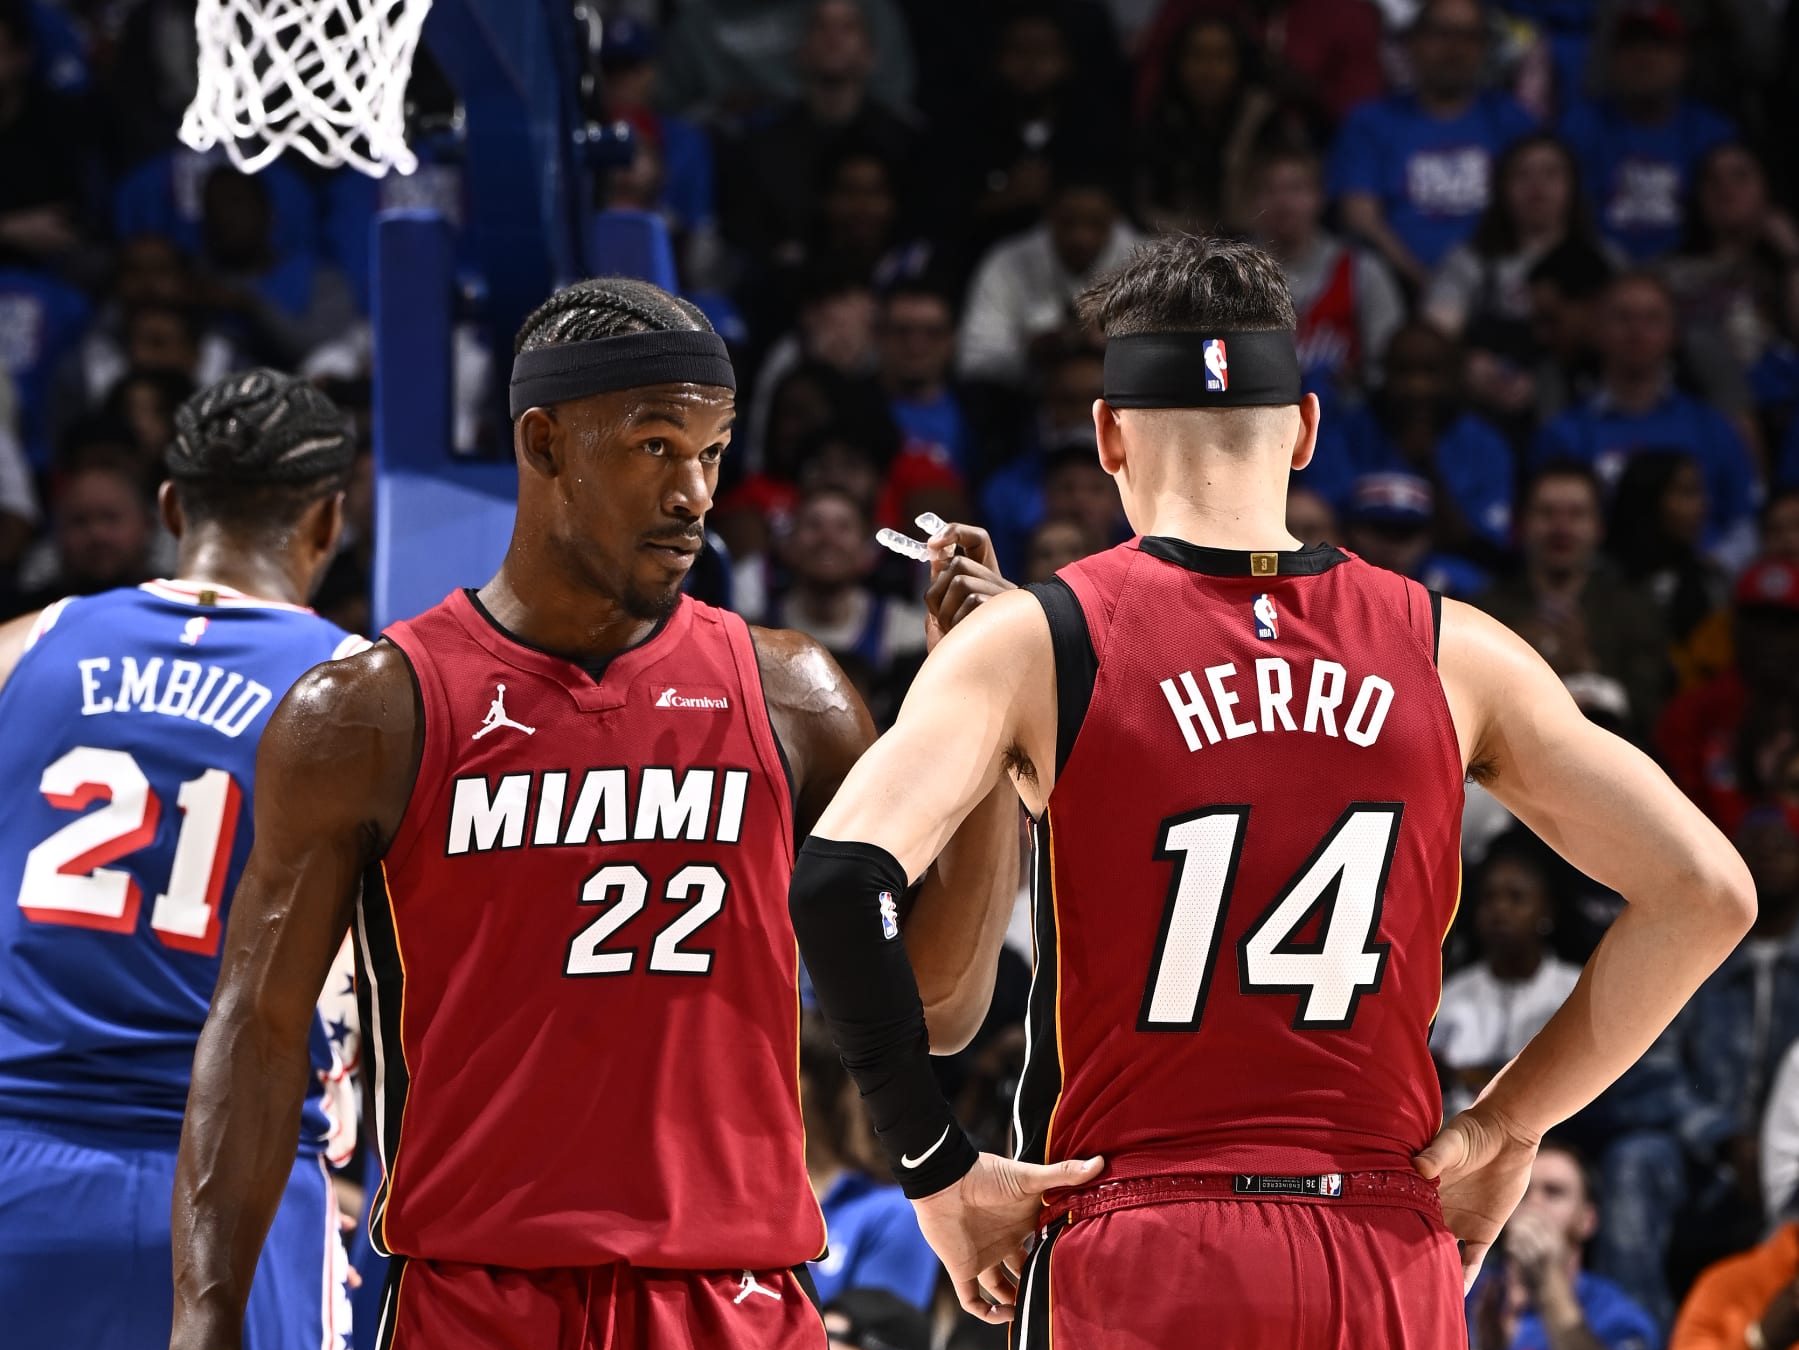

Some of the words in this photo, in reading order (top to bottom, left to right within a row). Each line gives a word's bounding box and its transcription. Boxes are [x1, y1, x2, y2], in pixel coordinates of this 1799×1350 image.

[1259, 628, 1272, 638] NBA
[77, 656, 273, 738] EMBIID
[671, 695, 729, 709] Carnival
[1159, 657, 1395, 753] HERRO
[17, 746, 243, 957] 21
[446, 767, 750, 856] MIAMI
[564, 863, 728, 976] 22
[1139, 805, 1401, 1029] 14
[1306, 1179, 1316, 1189] 36
